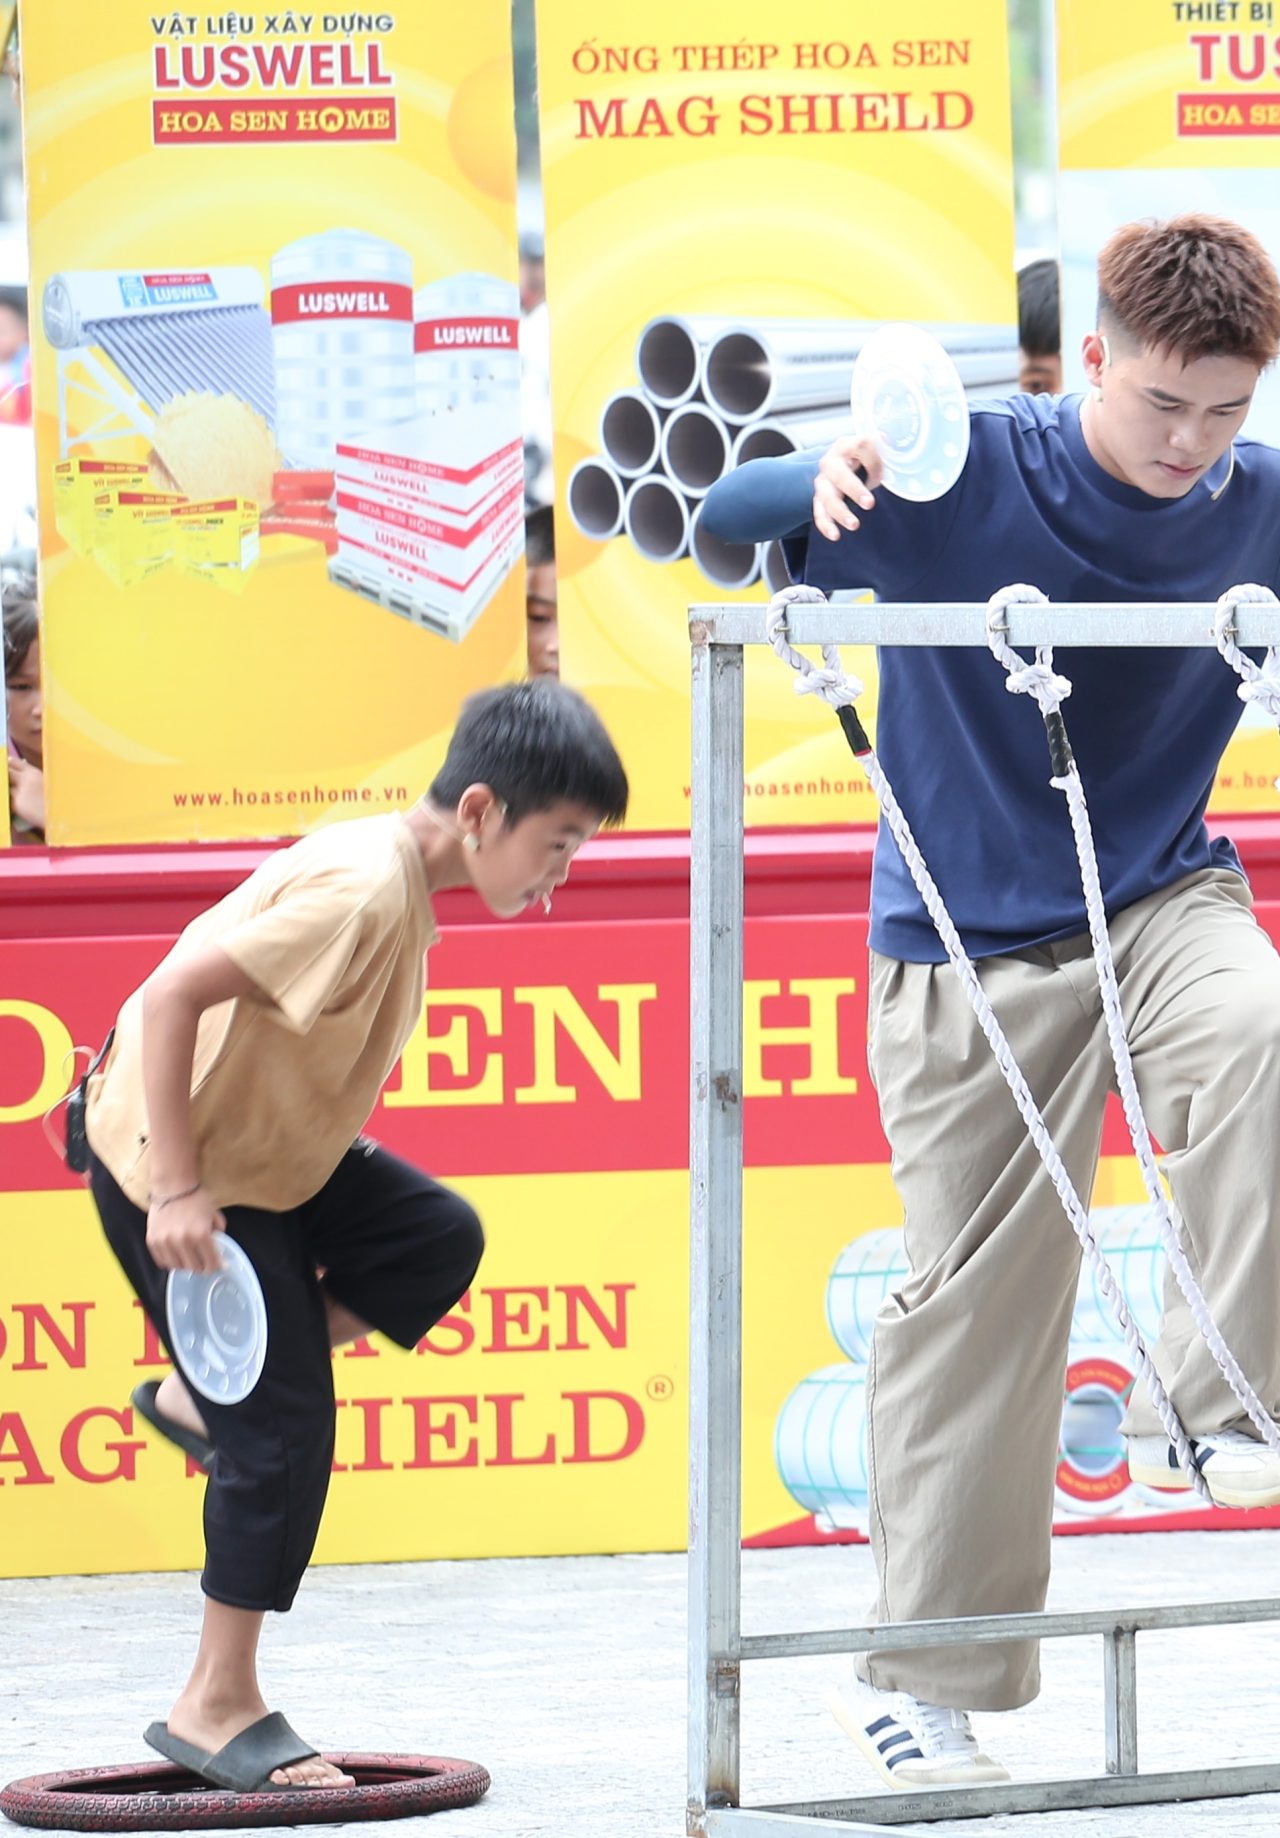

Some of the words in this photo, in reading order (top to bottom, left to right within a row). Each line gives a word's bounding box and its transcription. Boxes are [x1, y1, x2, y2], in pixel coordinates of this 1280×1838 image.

[151, 12, 198, 40] VẬT
[206, 11, 255, 40] LIỆU
[264, 10, 314, 34] XÂY
[322, 11, 394, 38] DỰNG
[1250, 1, 1273, 27] BỊ
[154, 43, 393, 88] LUSWELL
[571, 37, 661, 74] ỐNG
[673, 37, 779, 72] THÉP
[792, 41, 880, 69] HOA
[892, 39, 971, 67] SEN
[159, 111, 223, 133] HOA
[230, 109, 288, 132] SEN
[296, 106, 391, 133] HOME
[573, 95, 720, 139] MAG
[739, 91, 974, 136] SHIELD
[1182, 104, 1244, 127] HOA
[298, 292, 390, 313] LUSWELL
[433, 326, 511, 345] LUSWELL
[375, 530, 429, 561] LUSWELL
[173, 785, 408, 807] www.hoasenhome.vn
[383, 983, 657, 1108] EN
